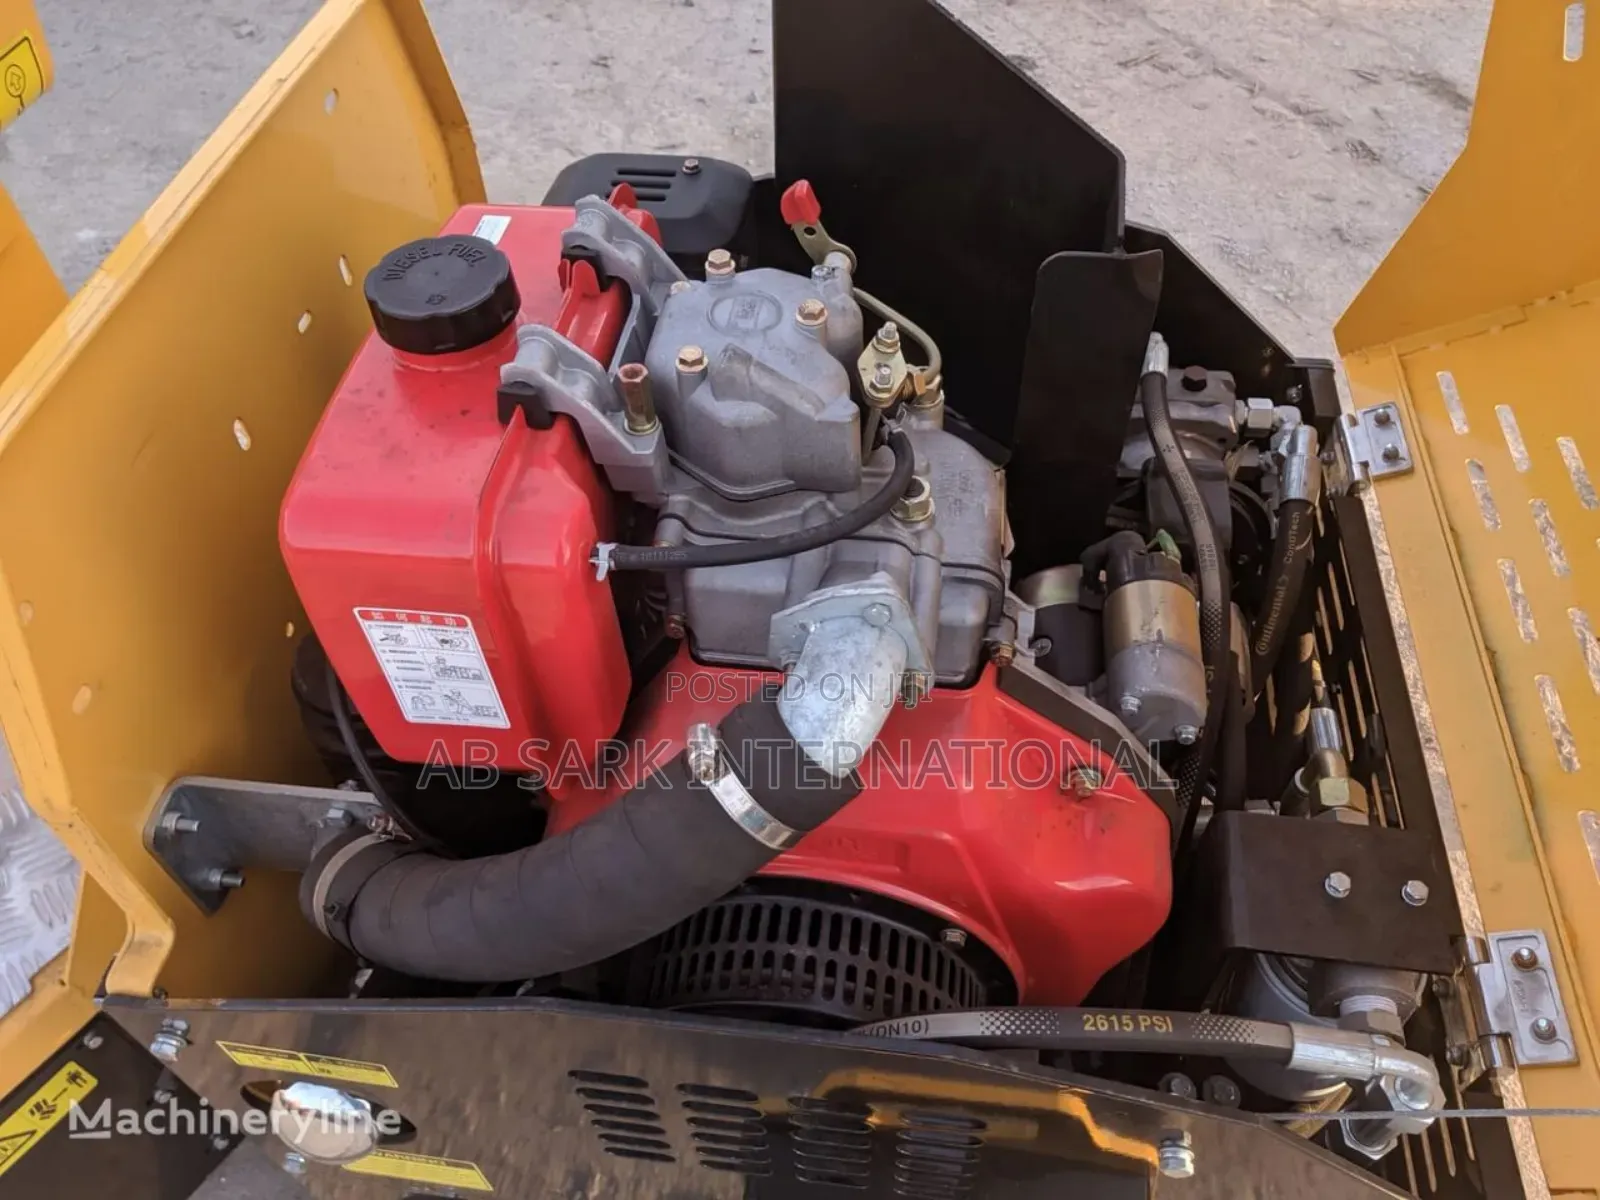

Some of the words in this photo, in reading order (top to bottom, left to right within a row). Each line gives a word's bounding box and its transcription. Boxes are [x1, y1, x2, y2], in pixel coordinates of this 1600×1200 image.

[448, 243, 487, 268] FUEL
[1083, 1013, 1134, 1032] 2615
[1138, 1014, 1173, 1033] PSI
